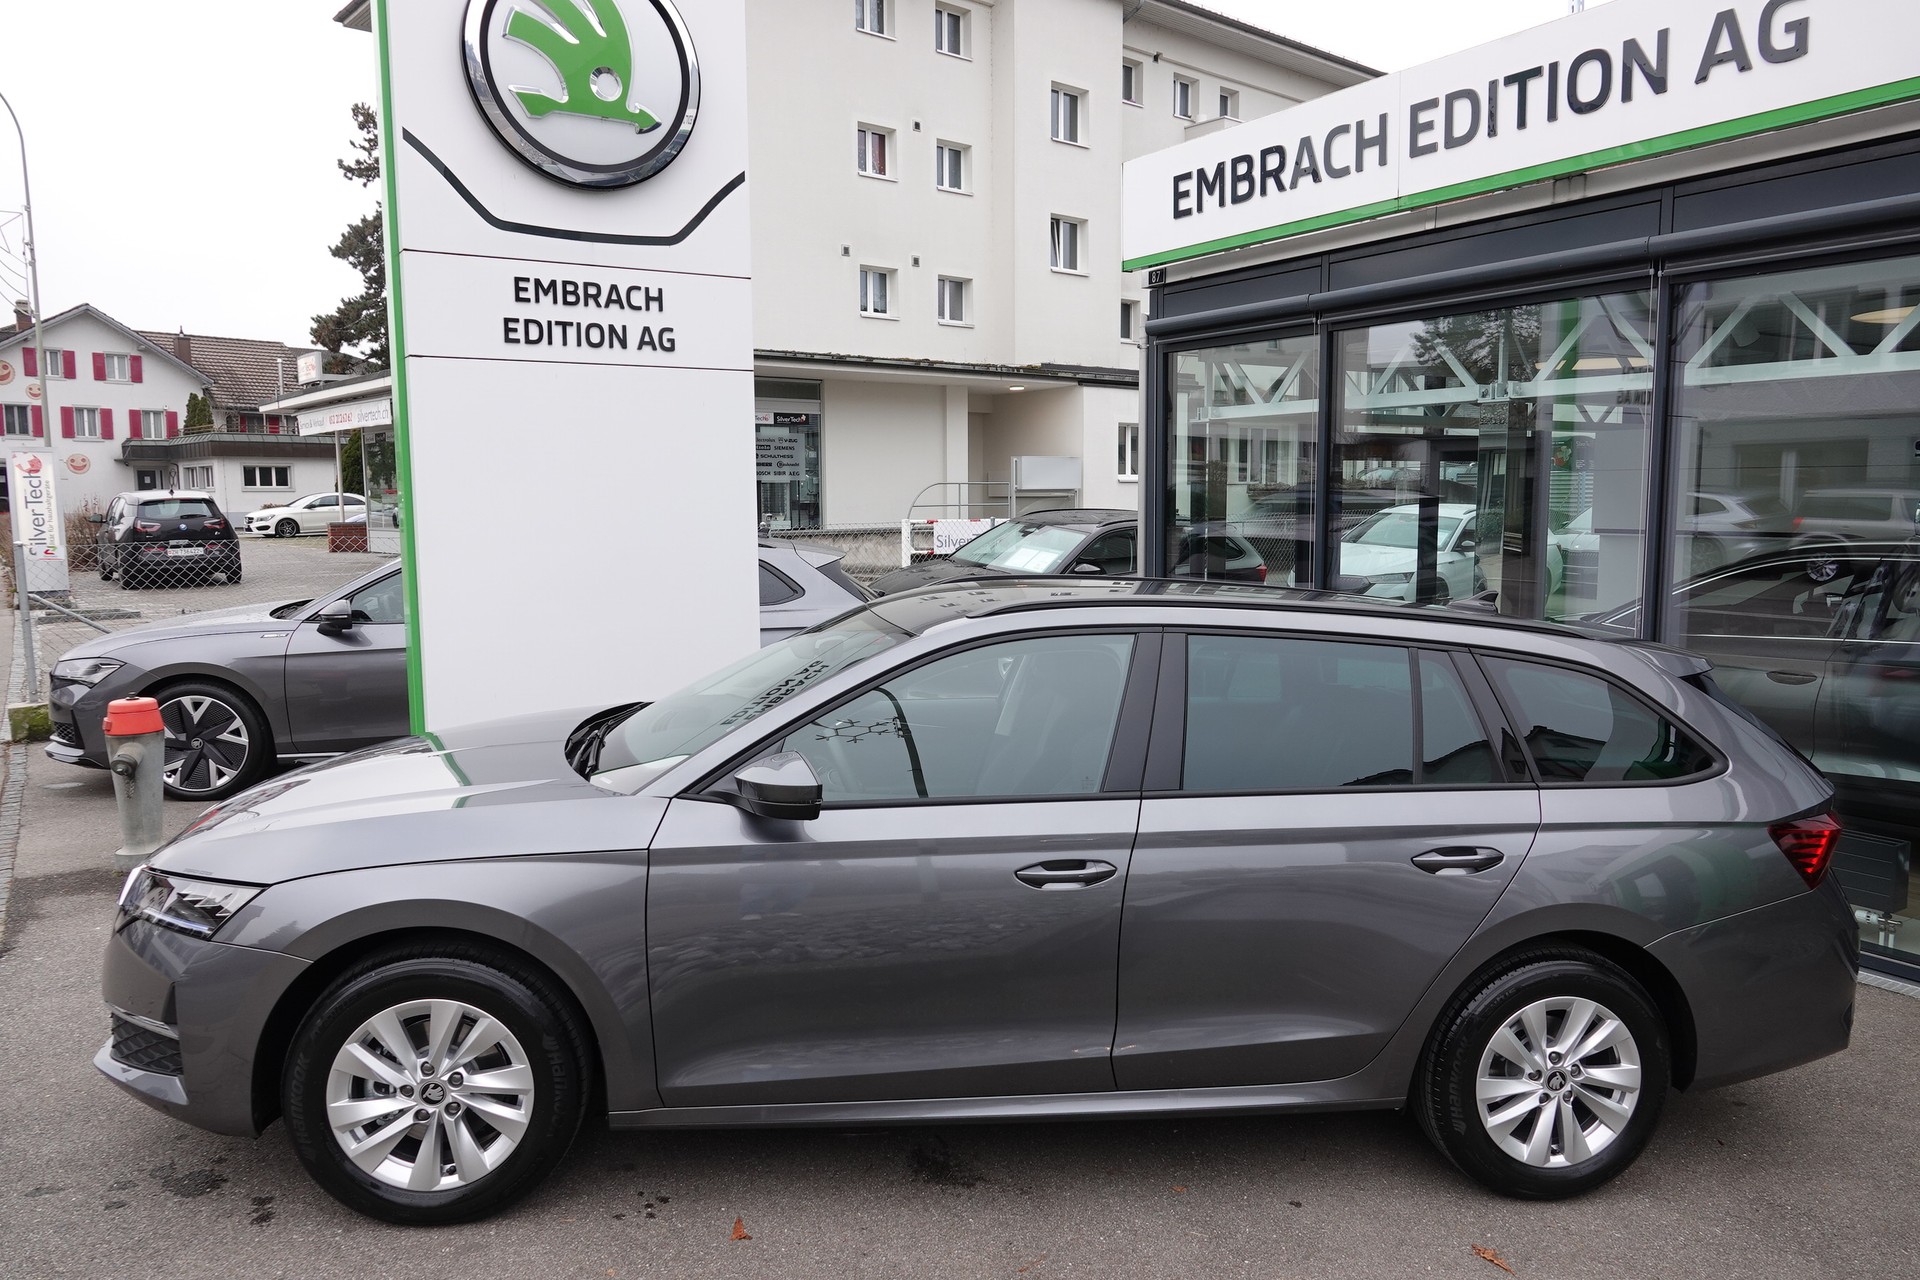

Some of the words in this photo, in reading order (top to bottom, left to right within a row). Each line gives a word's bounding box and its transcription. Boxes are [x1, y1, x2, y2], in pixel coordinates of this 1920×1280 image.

[1173, 112, 1389, 219] EMBRACH
[1409, 27, 1670, 159] EDITION
[1694, 0, 1810, 85] AG
[514, 276, 664, 312] EMBRACH
[1151, 270, 1161, 283] 87
[503, 317, 628, 350] EDITION
[636, 326, 676, 352] AG
[357, 406, 389, 423] silvertech.ch
